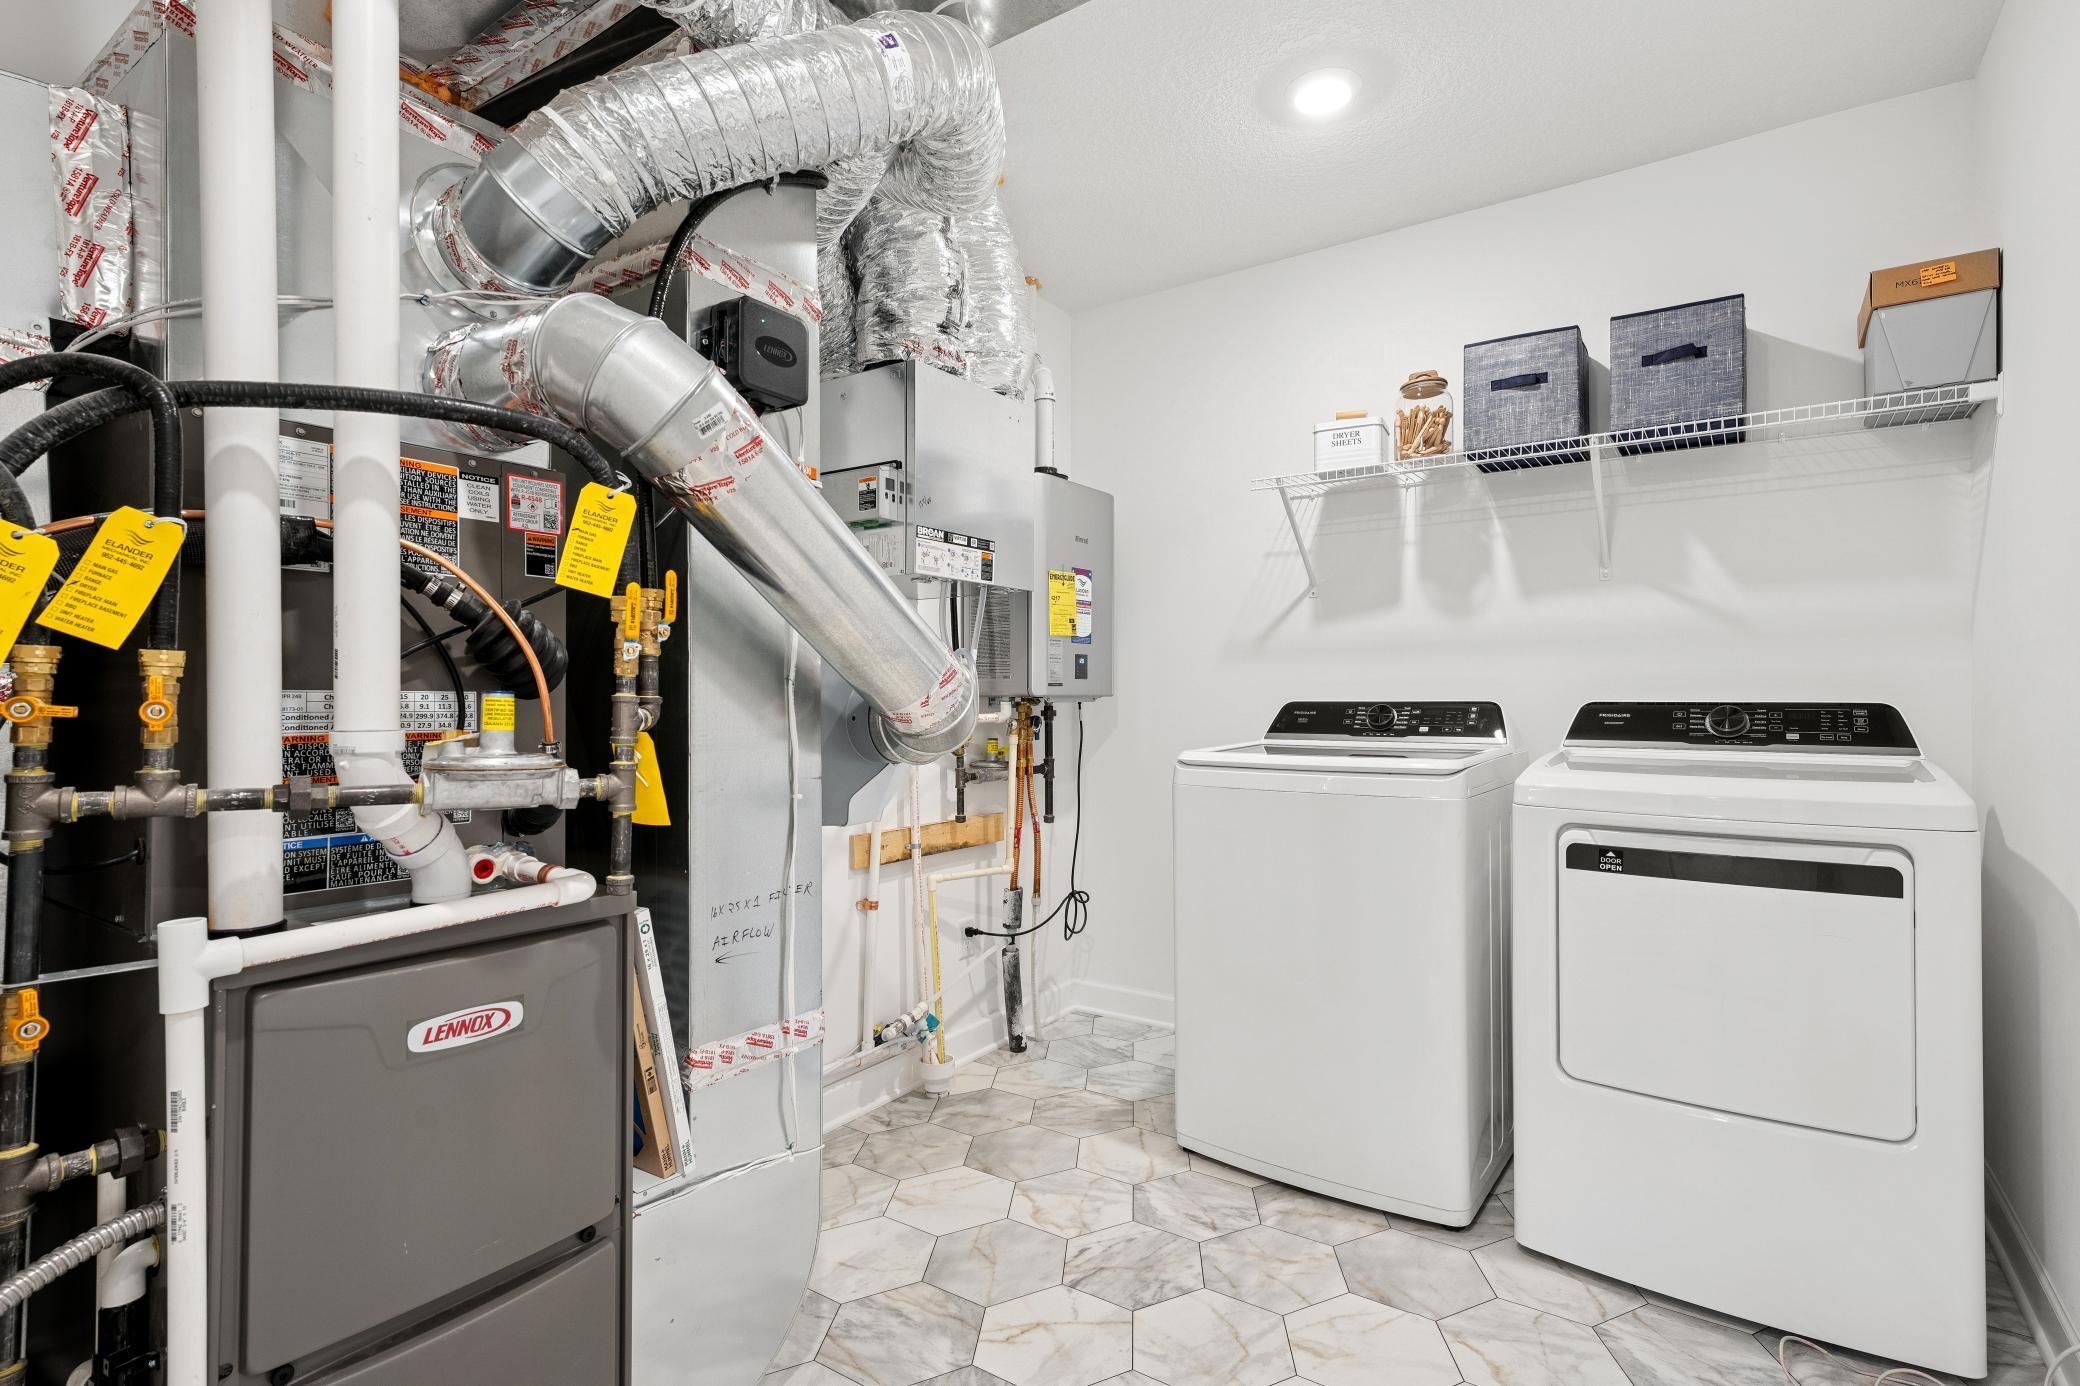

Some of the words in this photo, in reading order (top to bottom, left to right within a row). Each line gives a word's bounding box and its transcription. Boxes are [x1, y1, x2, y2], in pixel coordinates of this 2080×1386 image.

[1895, 278, 1921, 289] MX6
[763, 343, 788, 360] LENNOX
[1332, 430, 1361, 440] DRYER
[1331, 437, 1362, 448] SHEETS
[400, 459, 422, 469] NING
[427, 471, 457, 482] DEVICES
[461, 473, 496, 484] NOTICE
[400, 480, 430, 490] STALLED
[431, 482, 440, 491] IN
[444, 486, 457, 494] THE
[425, 477, 457, 488] SOURCES
[467, 483, 491, 491] CLEAN
[403, 486, 423, 495] THAN
[424, 489, 457, 499] AUXILIARY
[467, 489, 490, 497] COILS
[407, 492, 420, 500] USE
[422, 495, 441, 504] WITH
[445, 498, 457, 506] THE
[467, 495, 491, 503] USING
[521, 494, 543, 503] R-454B
[466, 501, 492, 509] WATER
[400, 506, 432, 516] SEMENT
[582, 508, 619, 524] ELANDER
[400, 521, 423, 530] UVENT
[417, 517, 457, 528] DISPOSITIFS
[400, 528, 420, 536] ATION
[420, 530, 429, 538] NE
[430, 531, 456, 540] DOIVENT
[917, 526, 945, 539] BROAN
[101, 545, 138, 562] MECHANICAL
[104, 538, 154, 561] ELANDER
[93, 562, 107, 571] MAIN
[107, 567, 119, 575] GAS
[88, 568, 113, 580] FURNACE
[84, 575, 102, 585] RANGE
[79, 582, 98, 592] DRYER
[74, 589, 102, 602] FIREPLACE
[103, 598, 119, 607] MAIN
[64, 602, 78, 611] BBQ
[69, 595, 99, 609] FIREPLACE
[99, 605, 128, 619] BASEMENT
[60, 609, 73, 617] UNIT
[74, 613, 95, 624] HEATER
[54, 616, 74, 627] WATER
[74, 622, 96, 633] HEATER
[439, 703, 452, 711] 11.3
[282, 713, 329, 721] Conditioned
[415, 712, 434, 720] 299.9
[435, 712, 454, 720] 374.8
[282, 723, 330, 732] Conditioned
[297, 742, 330, 751] DISPOS
[294, 749, 331, 757] ACCORD
[282, 756, 305, 765] ERAL
[302, 762, 335, 770] FLAMM
[283, 829, 313, 838] ABLE.
[282, 841, 303, 849] TICE
[298, 848, 327, 858] SYSTEM
[330, 853, 341, 861] DE
[346, 851, 372, 859] FUITE
[303, 855, 326, 865] MUST
[1600, 856, 1622, 864] DOOR
[293, 862, 325, 873] EXCEPT
[1599, 863, 1623, 871] OPEN
[330, 873, 352, 882] SAUF
[358, 870, 383, 878] POUR
[768, 881, 813, 903] FILER
[712, 923, 775, 951] AIRFLOW
[422, 1012, 496, 1046] LENNOX
